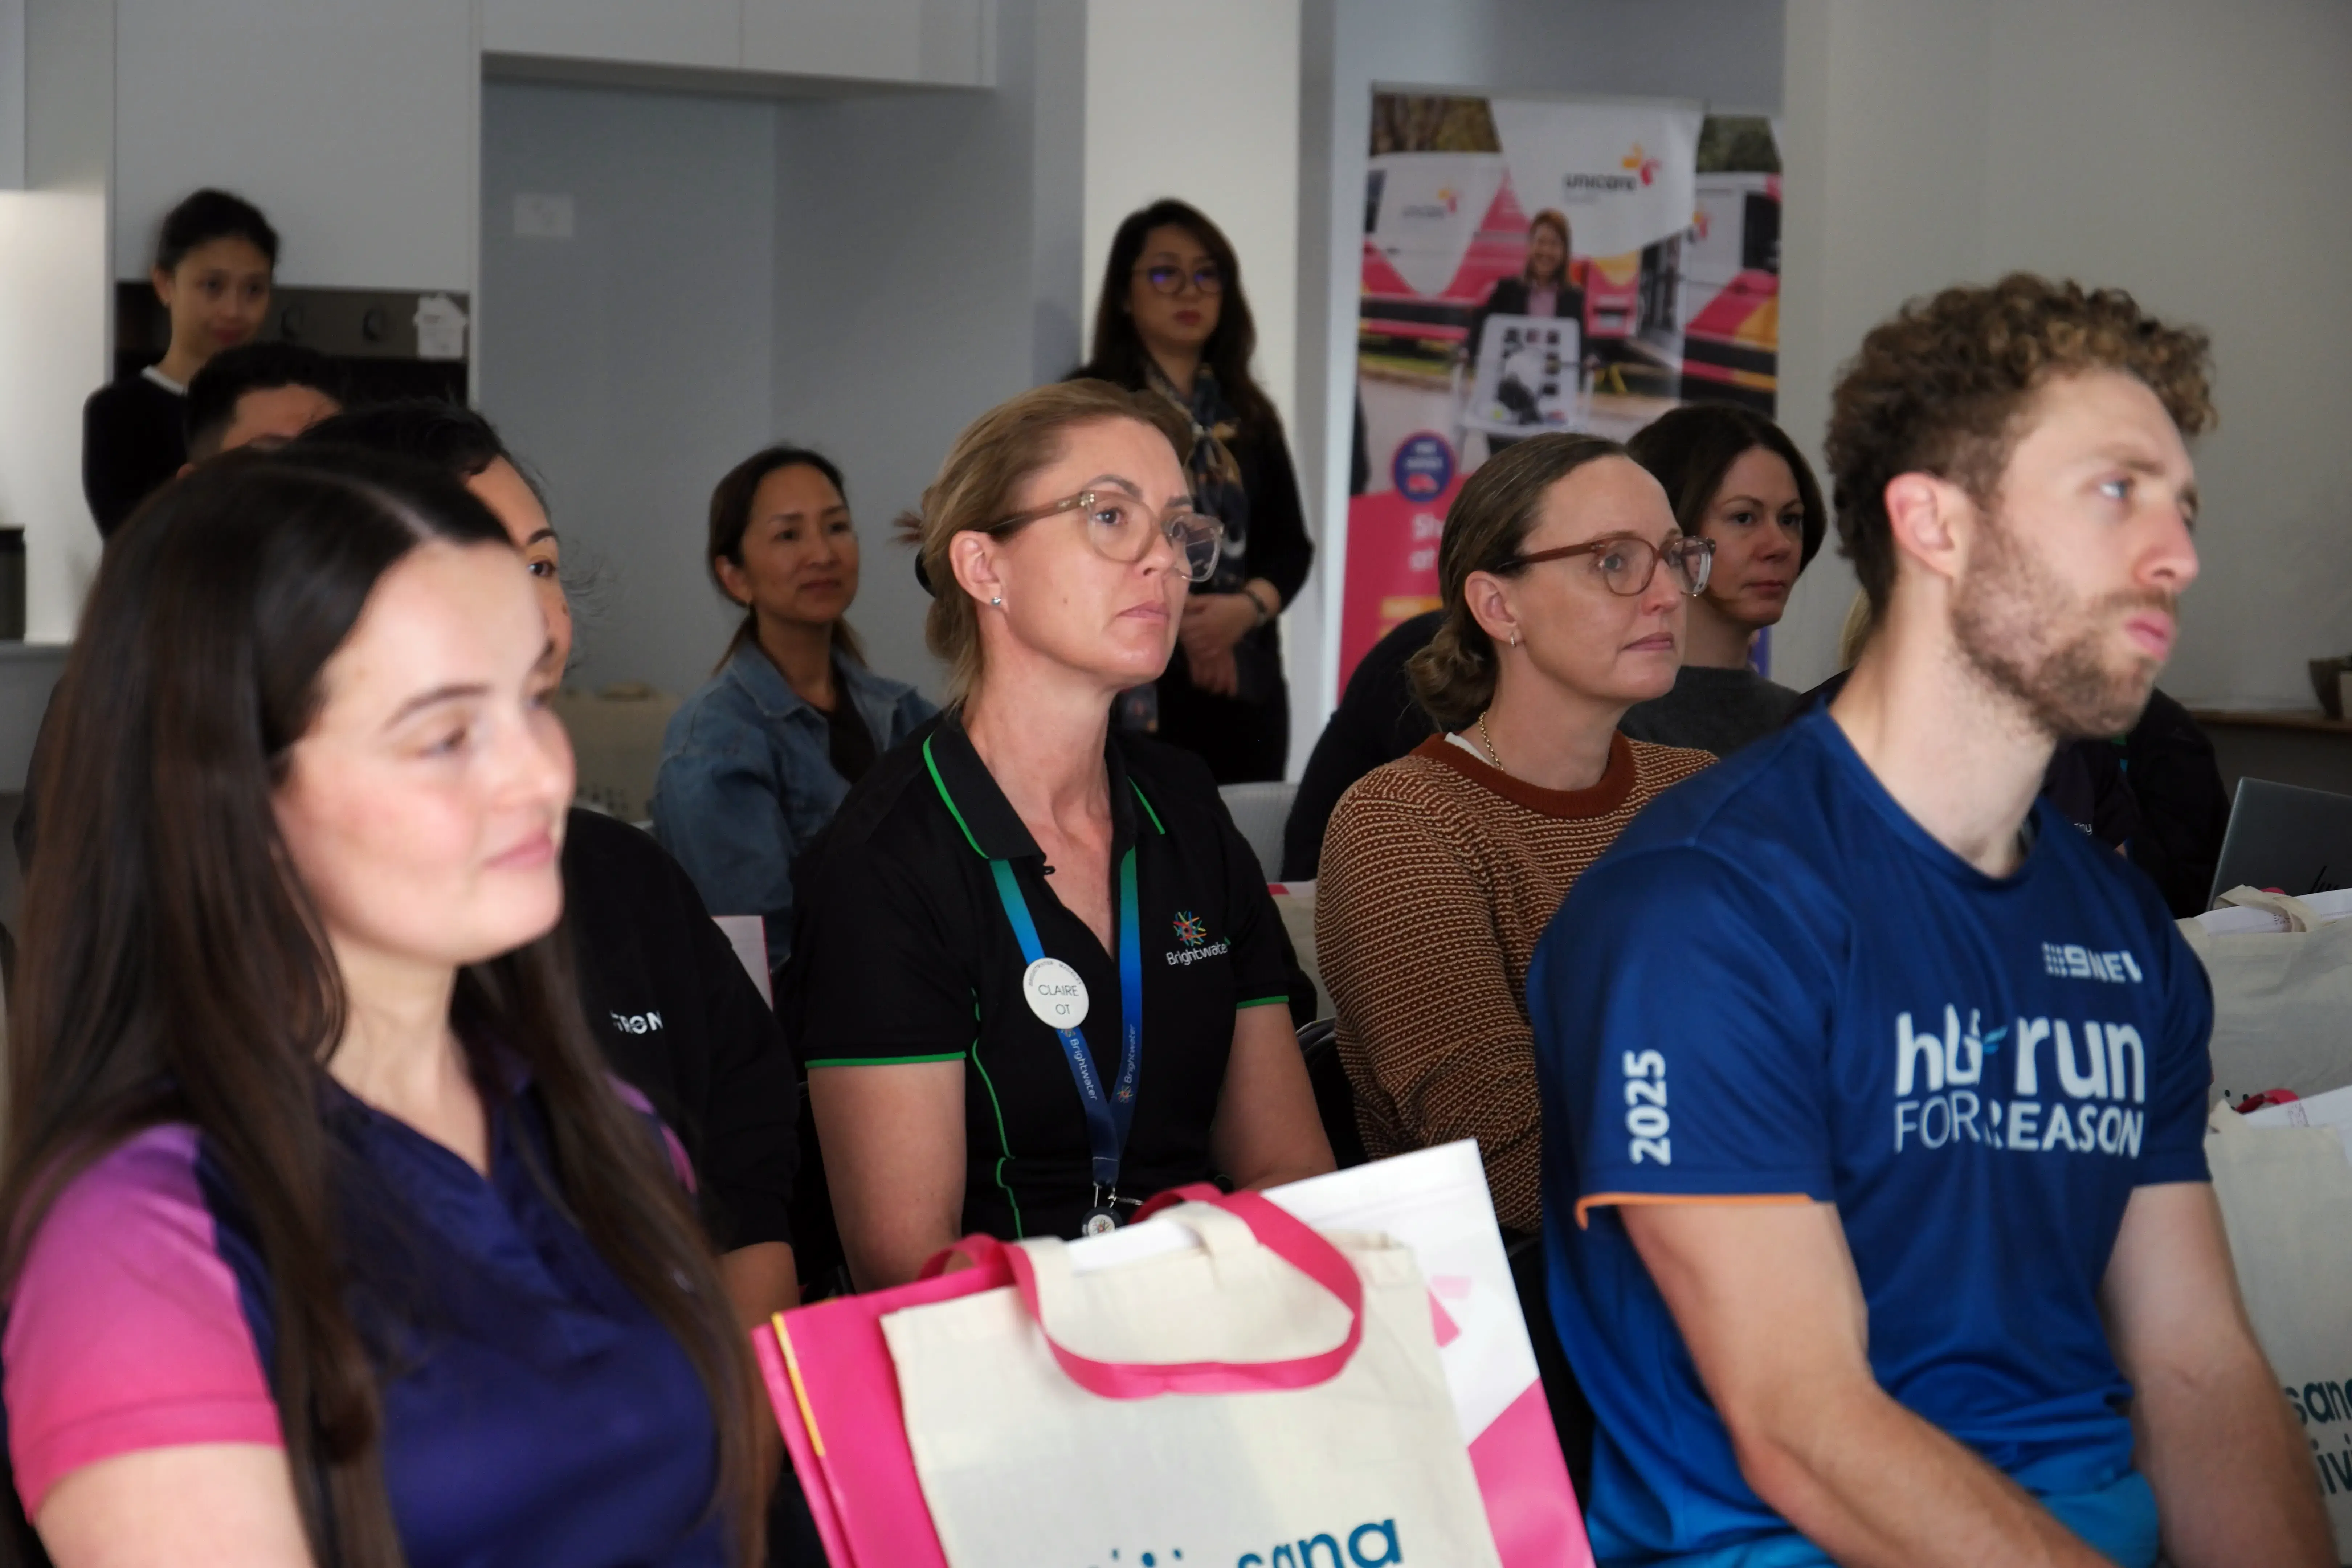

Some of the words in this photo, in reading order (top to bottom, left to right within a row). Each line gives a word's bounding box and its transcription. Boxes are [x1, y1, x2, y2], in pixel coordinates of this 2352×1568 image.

[1166, 941, 1228, 966] Brightwate
[1038, 984, 1079, 996] CLAIRE
[1055, 1004, 1070, 1015] OT
[1070, 1038, 1098, 1101] Brightwater
[1124, 1023, 1136, 1084] Brightwater
[2014, 1016, 2146, 1104] run
[1622, 1048, 1672, 1166] 2025
[1894, 1090, 1981, 1154] FOR
